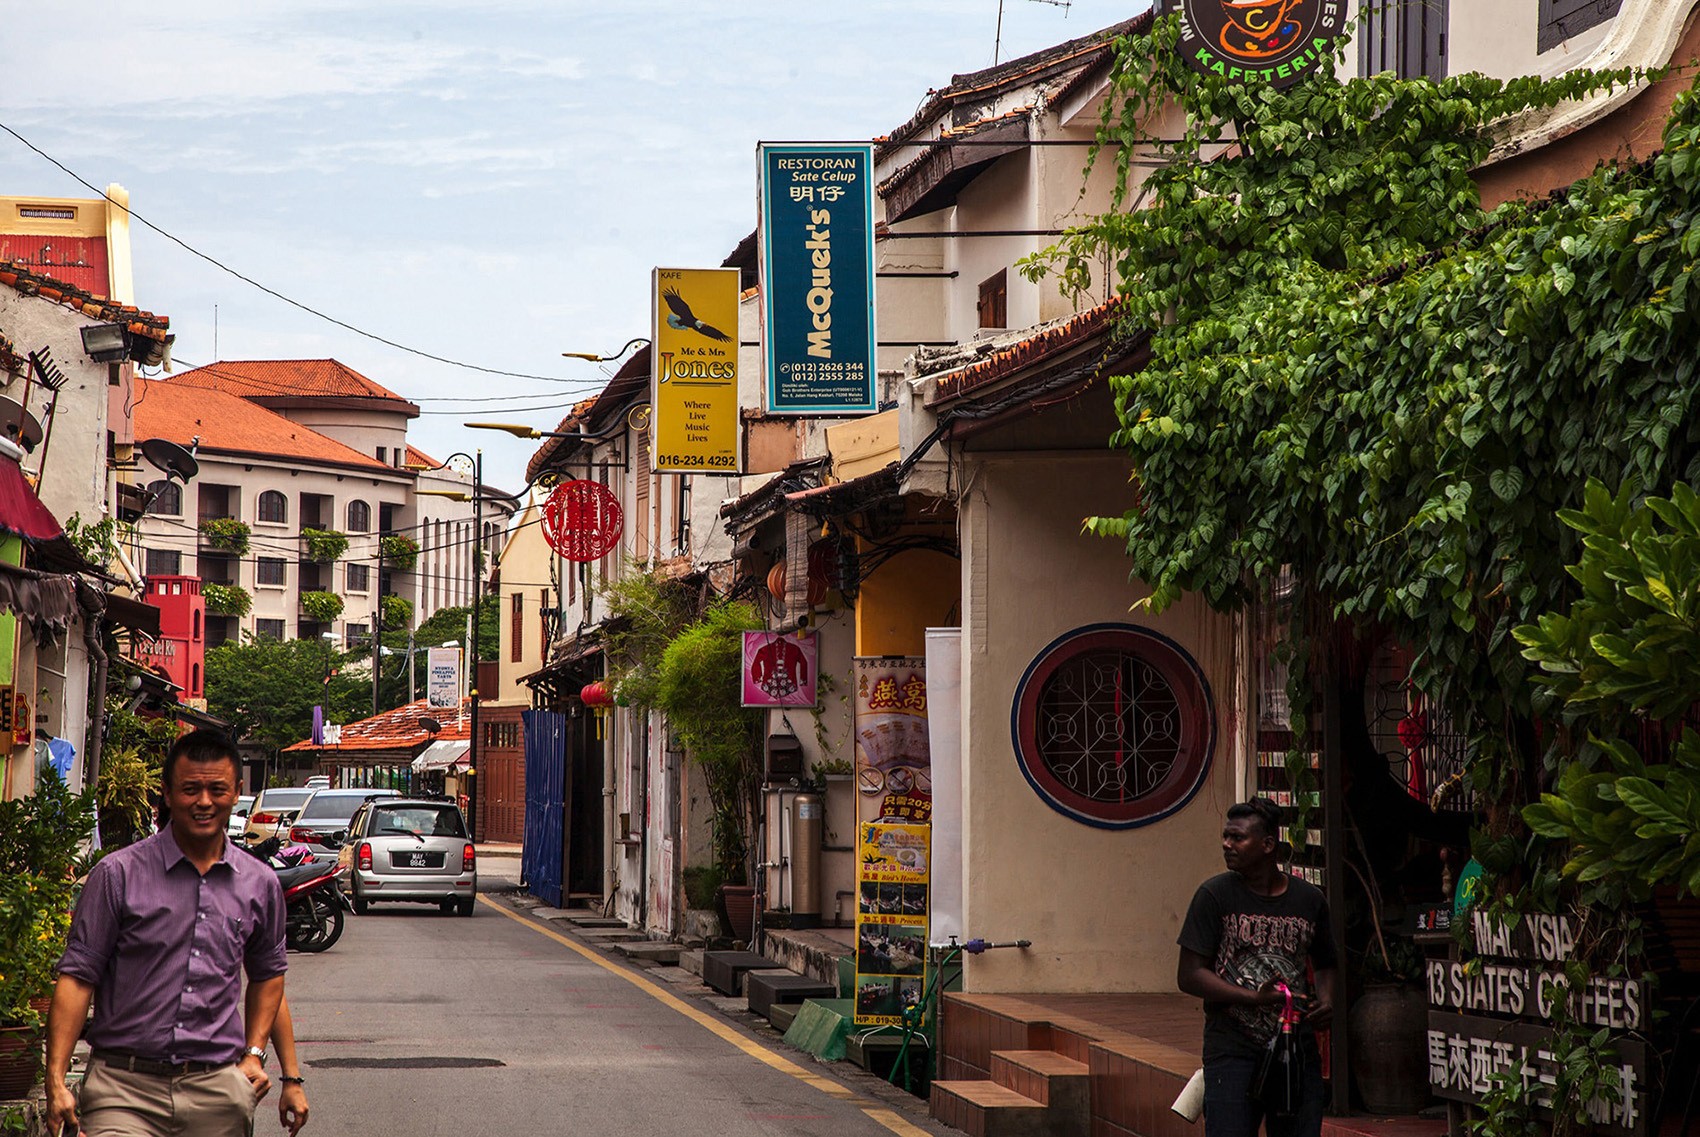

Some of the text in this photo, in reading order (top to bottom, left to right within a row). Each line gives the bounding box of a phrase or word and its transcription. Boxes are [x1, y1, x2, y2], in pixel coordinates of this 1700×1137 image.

[1321, 0, 1338, 28] ES
[1195, 37, 1327, 83] KAFETERIA
[778, 158, 856, 169] RESTORAN
[792, 171, 856, 184] Sate Celup
[789, 185, 845, 202] 明仔
[660, 271, 681, 279] KAFE
[805, 208, 834, 358] McQuek's
[698, 347, 706, 356] &
[708, 347, 725, 357] Mrs
[660, 352, 735, 383] Jones
[791, 362, 864, 373] (012) 2626 344
[792, 372, 864, 383] (012) 2555 285
[684, 401, 711, 410] Where
[690, 412, 706, 421] Live
[685, 423, 710, 432] Music
[687, 434, 708, 443] Lives
[659, 455, 735, 466] 016-234 4292
[1472, 911, 1574, 961] MALYSIA
[1426, 961, 1446, 1006] 13
[1537, 972, 1641, 1030] CFEES
